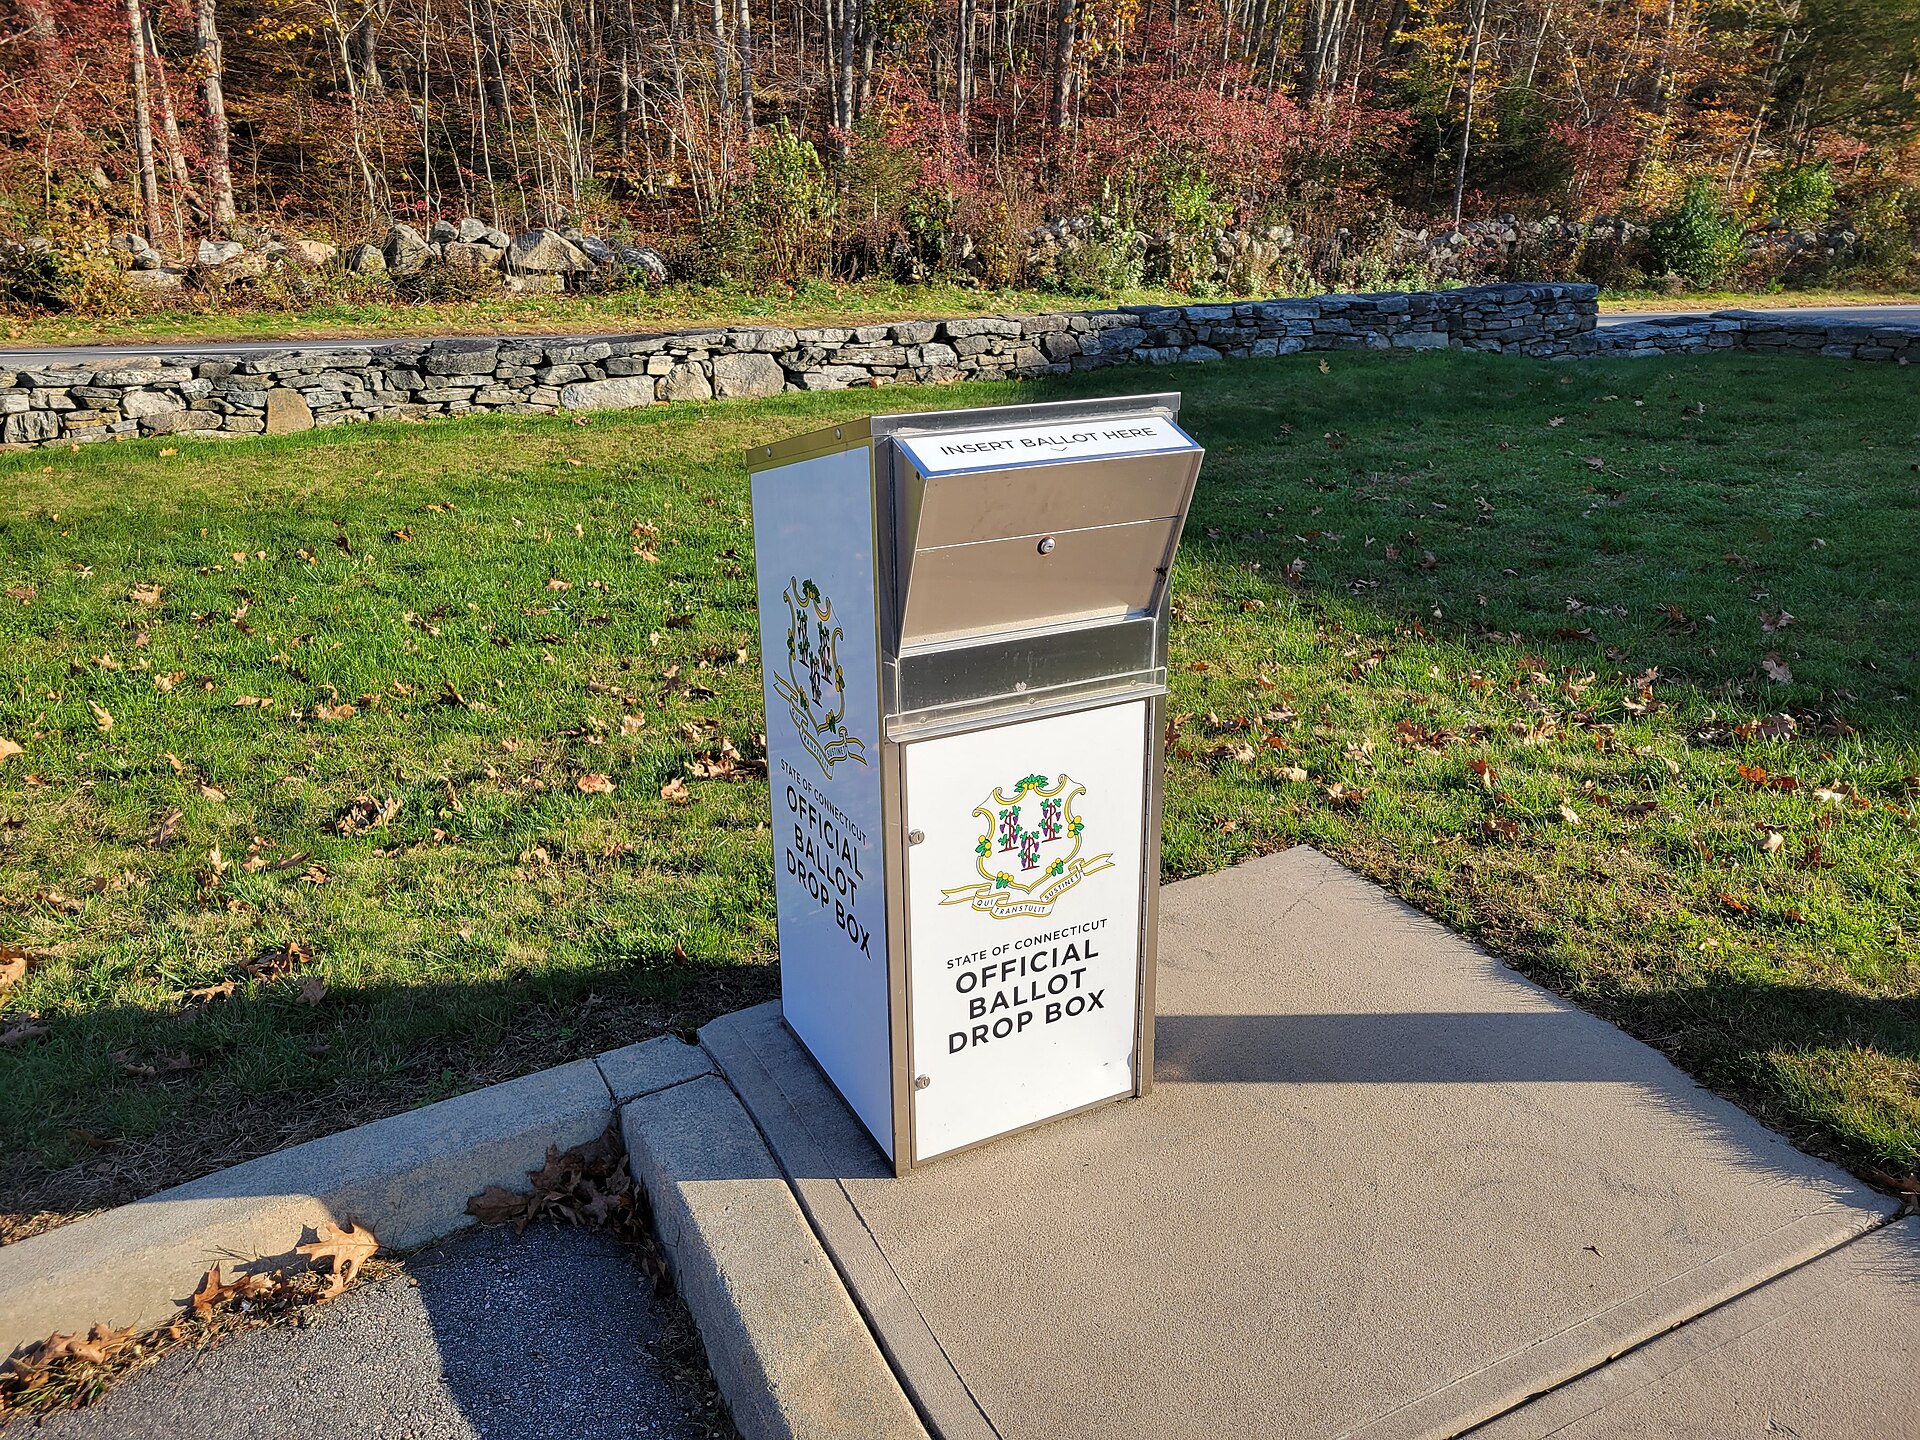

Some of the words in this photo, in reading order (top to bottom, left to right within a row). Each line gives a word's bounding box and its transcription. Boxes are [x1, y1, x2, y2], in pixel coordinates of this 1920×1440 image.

[940, 440, 1014, 456] INSERT
[1020, 432, 1098, 448] BALLOT
[1102, 427, 1157, 440] HERE
[781, 758, 801, 785] STATE
[802, 778, 812, 794] OF
[814, 789, 866, 846] CONNECTICUT
[786, 785, 864, 880] OFFICIAL
[795, 822, 857, 907] BALLOT
[976, 899, 993, 907] QUI
[994, 905, 1046, 915] TRANSTULIT
[1044, 873, 1080, 900] SUSTINET
[786, 847, 830, 908] DROP
[835, 898, 871, 960] BOX
[947, 949, 987, 969] STATE
[991, 943, 1010, 957] OF
[1014, 918, 1108, 950] CONNECTICUT
[955, 939, 1099, 994] OFFICIAL
[949, 1010, 1033, 1054] DROP
[1045, 989, 1105, 1025] BOX
[969, 967, 1087, 1020] BALLOT
